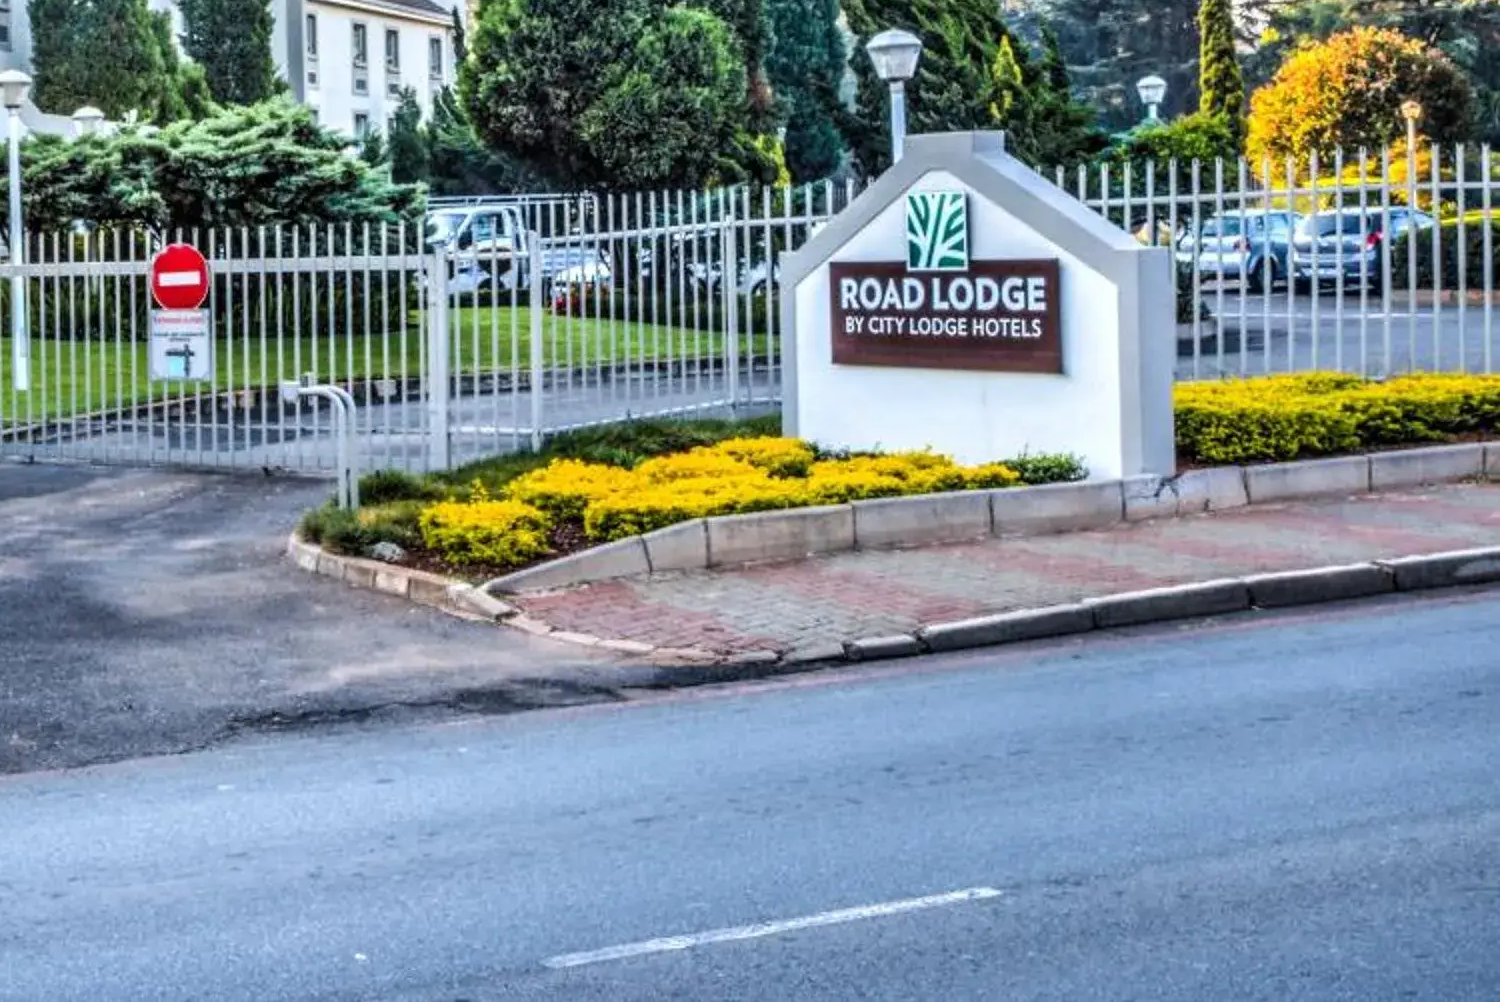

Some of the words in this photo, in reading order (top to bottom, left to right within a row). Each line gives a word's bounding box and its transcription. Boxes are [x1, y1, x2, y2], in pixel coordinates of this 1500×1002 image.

[839, 277, 926, 310] ROAD
[931, 277, 1047, 312] LODGE
[845, 316, 863, 334] BY
[868, 316, 905, 335] CITY
[908, 317, 967, 336] LODGE
[971, 318, 1043, 338] HOTELS
